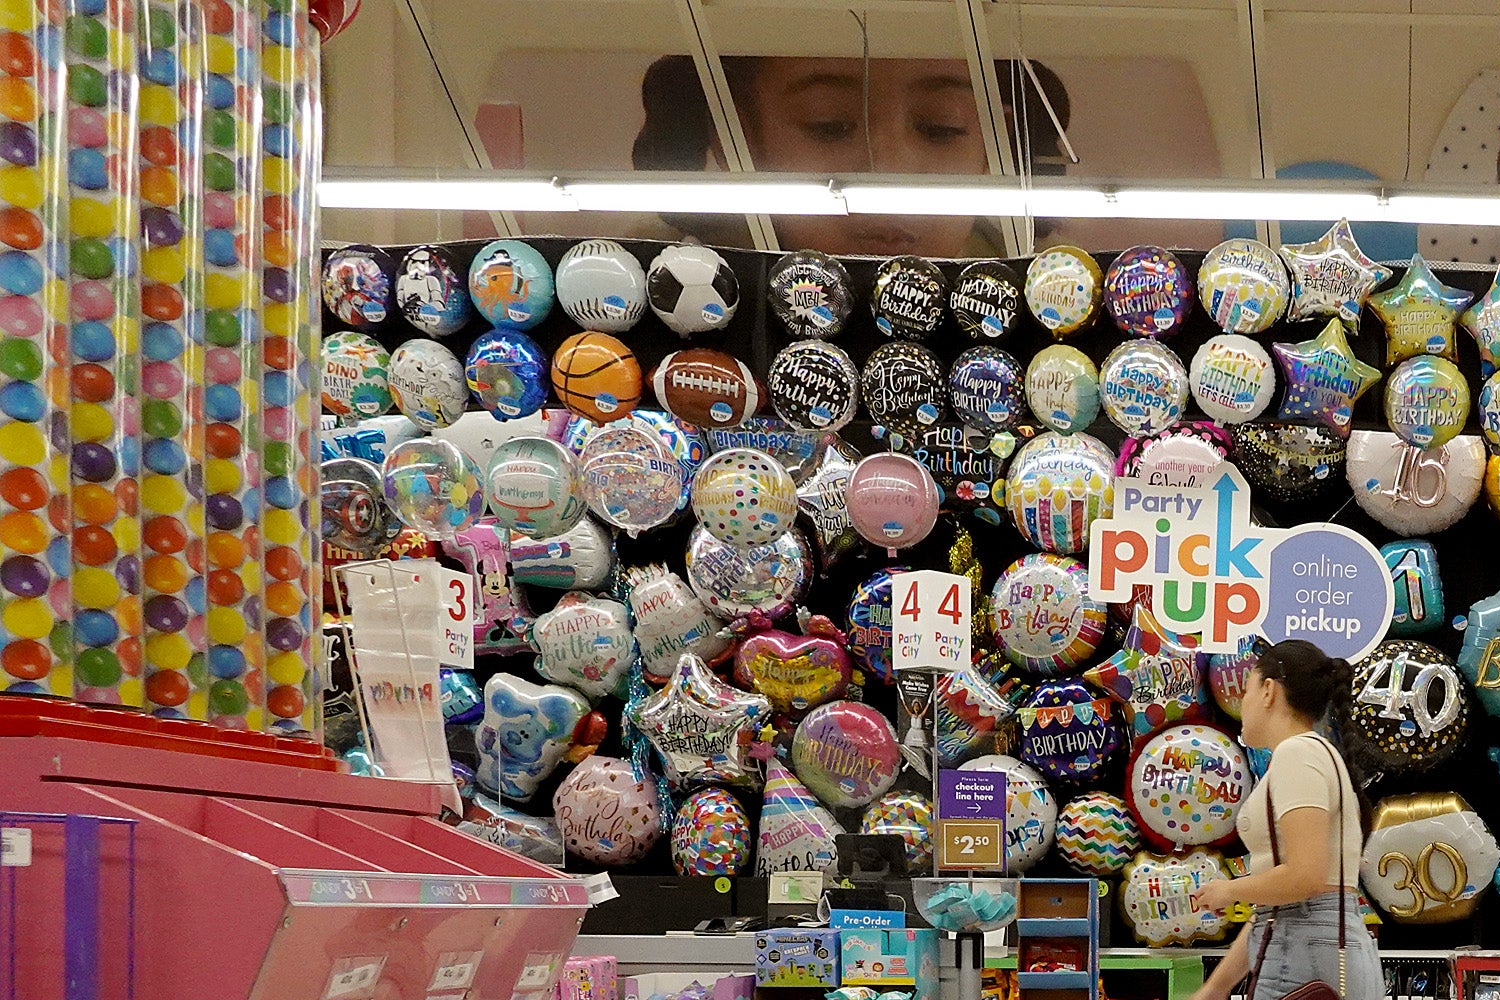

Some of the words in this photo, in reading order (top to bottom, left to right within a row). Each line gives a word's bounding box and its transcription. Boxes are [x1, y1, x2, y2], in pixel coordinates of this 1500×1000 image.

[327, 362, 358, 380] DINO
[330, 388, 349, 399] DAY!
[1124, 487, 1203, 520] Party
[1100, 516, 1264, 591] pick
[1292, 554, 1358, 579] online
[448, 579, 467, 621] 3
[900, 580, 921, 622] 4
[937, 584, 963, 625] 4
[1295, 586, 1354, 606] order
[1162, 580, 1261, 643] up
[1286, 609, 1361, 639] pickup
[445, 629, 469, 645] Party
[898, 633, 923, 646] Party
[935, 632, 963, 648] Party
[448, 643, 466, 657] City
[901, 644, 920, 658] City
[939, 646, 961, 661] City
[1357, 651, 1461, 737] 40
[1031, 728, 1107, 757] BIRTHDAY
[1162, 746, 1233, 777] HAPPY
[955, 783, 994, 791] checkout
[1143, 763, 1242, 804] BIRTHDAY
[956, 792, 971, 800] line
[974, 792, 993, 801] here
[1378, 840, 1469, 918] 30
[843, 916, 891, 926] Pre-Order
